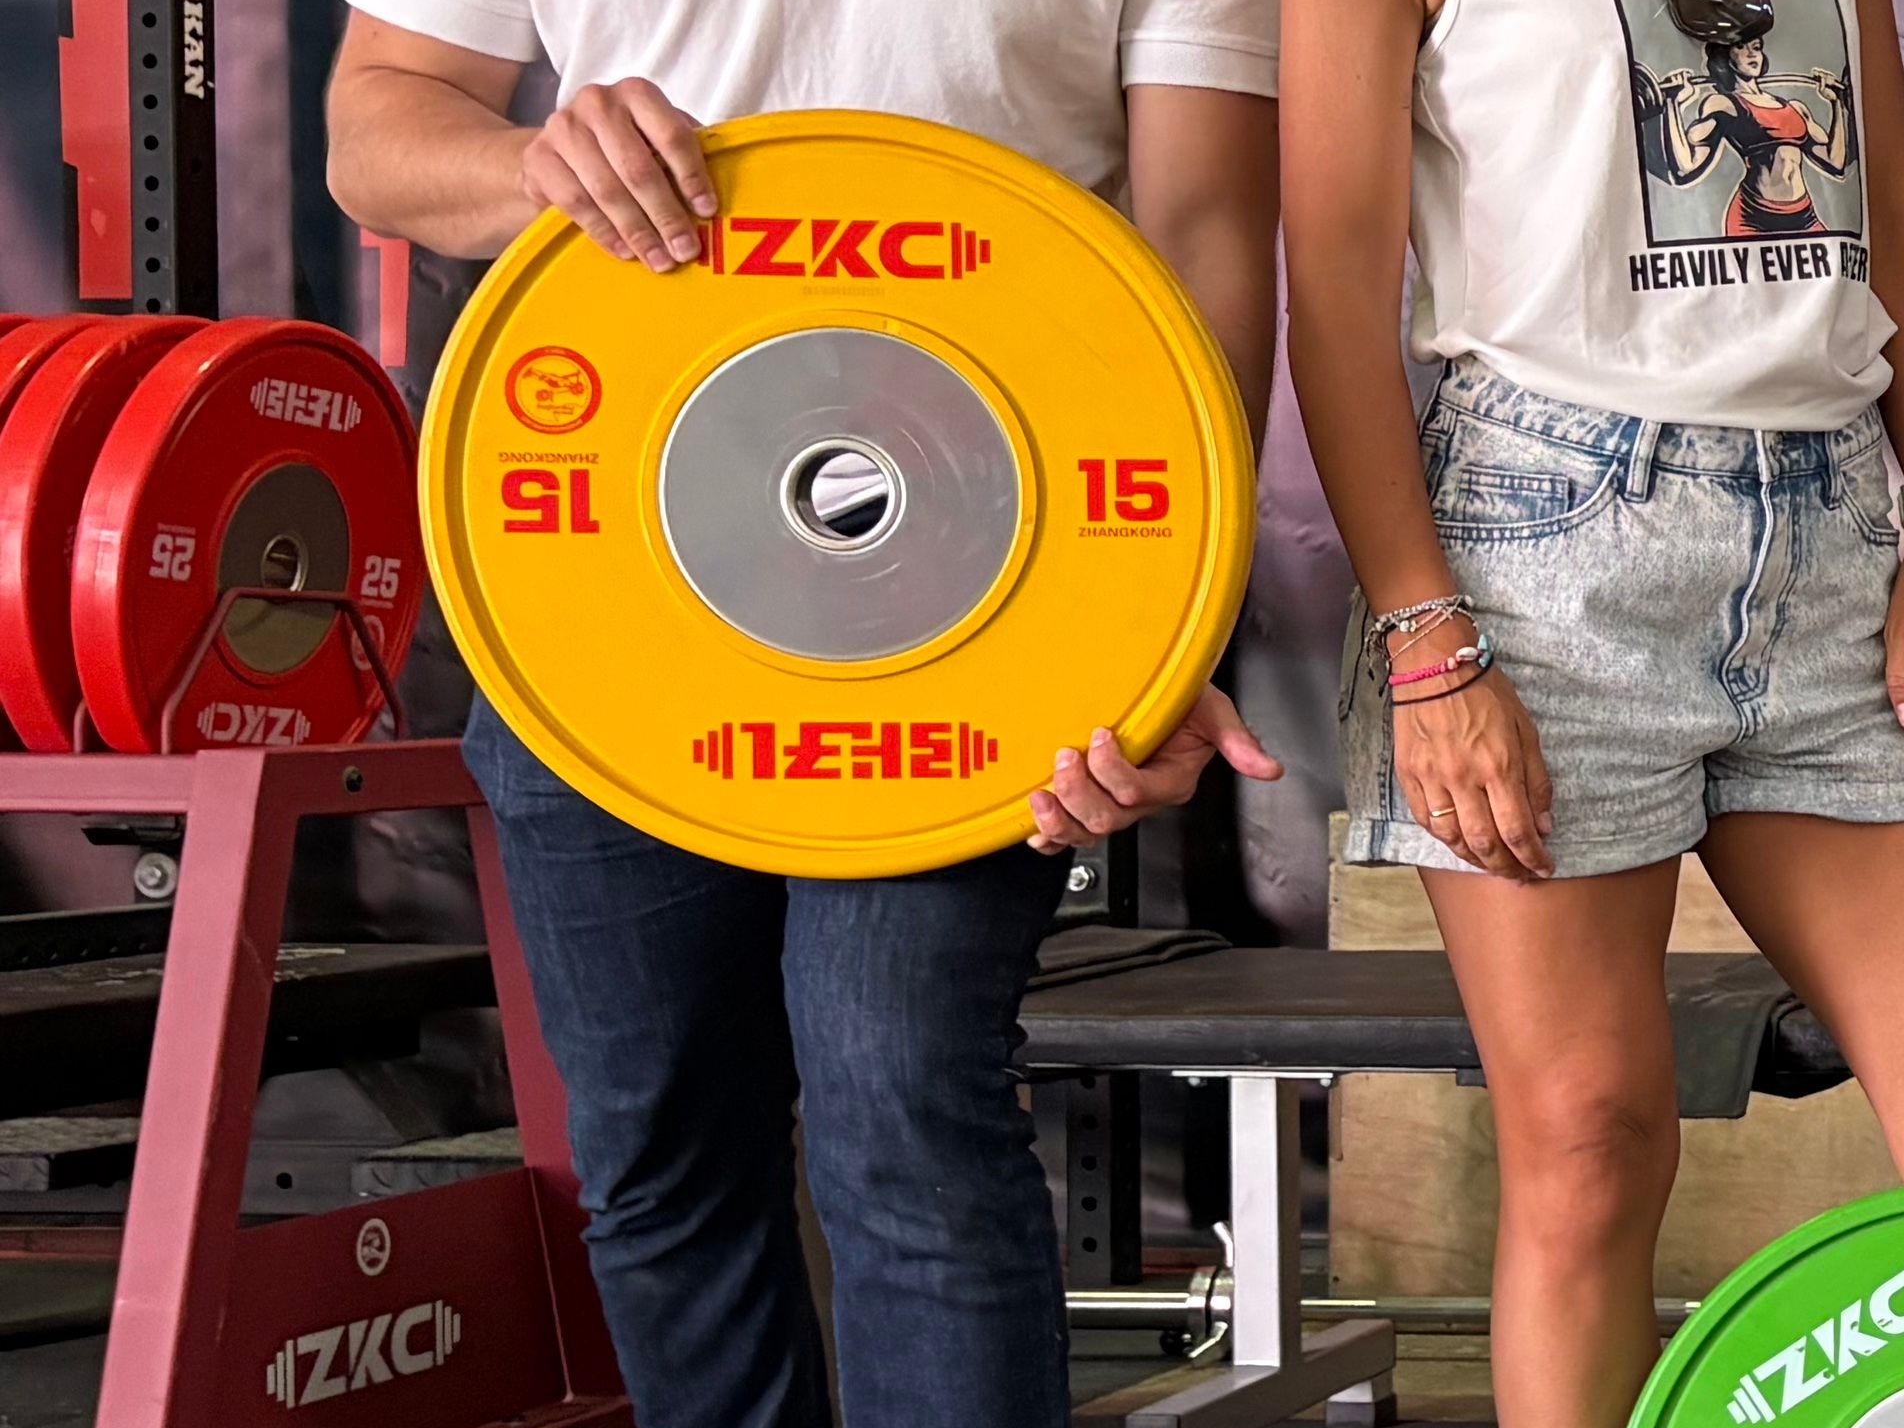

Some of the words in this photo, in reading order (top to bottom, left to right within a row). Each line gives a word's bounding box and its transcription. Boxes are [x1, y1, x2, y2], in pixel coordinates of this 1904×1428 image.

[732, 218, 943, 279] ZKC
[1629, 248, 1750, 292] HEAVILY
[1761, 242, 1831, 283] EVER
[498, 451, 600, 464] ZHANGKONG
[501, 468, 600, 534] 15
[1078, 458, 1169, 522] 15
[149, 534, 196, 582] 25
[1078, 527, 1173, 539] ZHANGKONG
[360, 555, 402, 599] 25
[297, 1303, 435, 1407] ZKC
